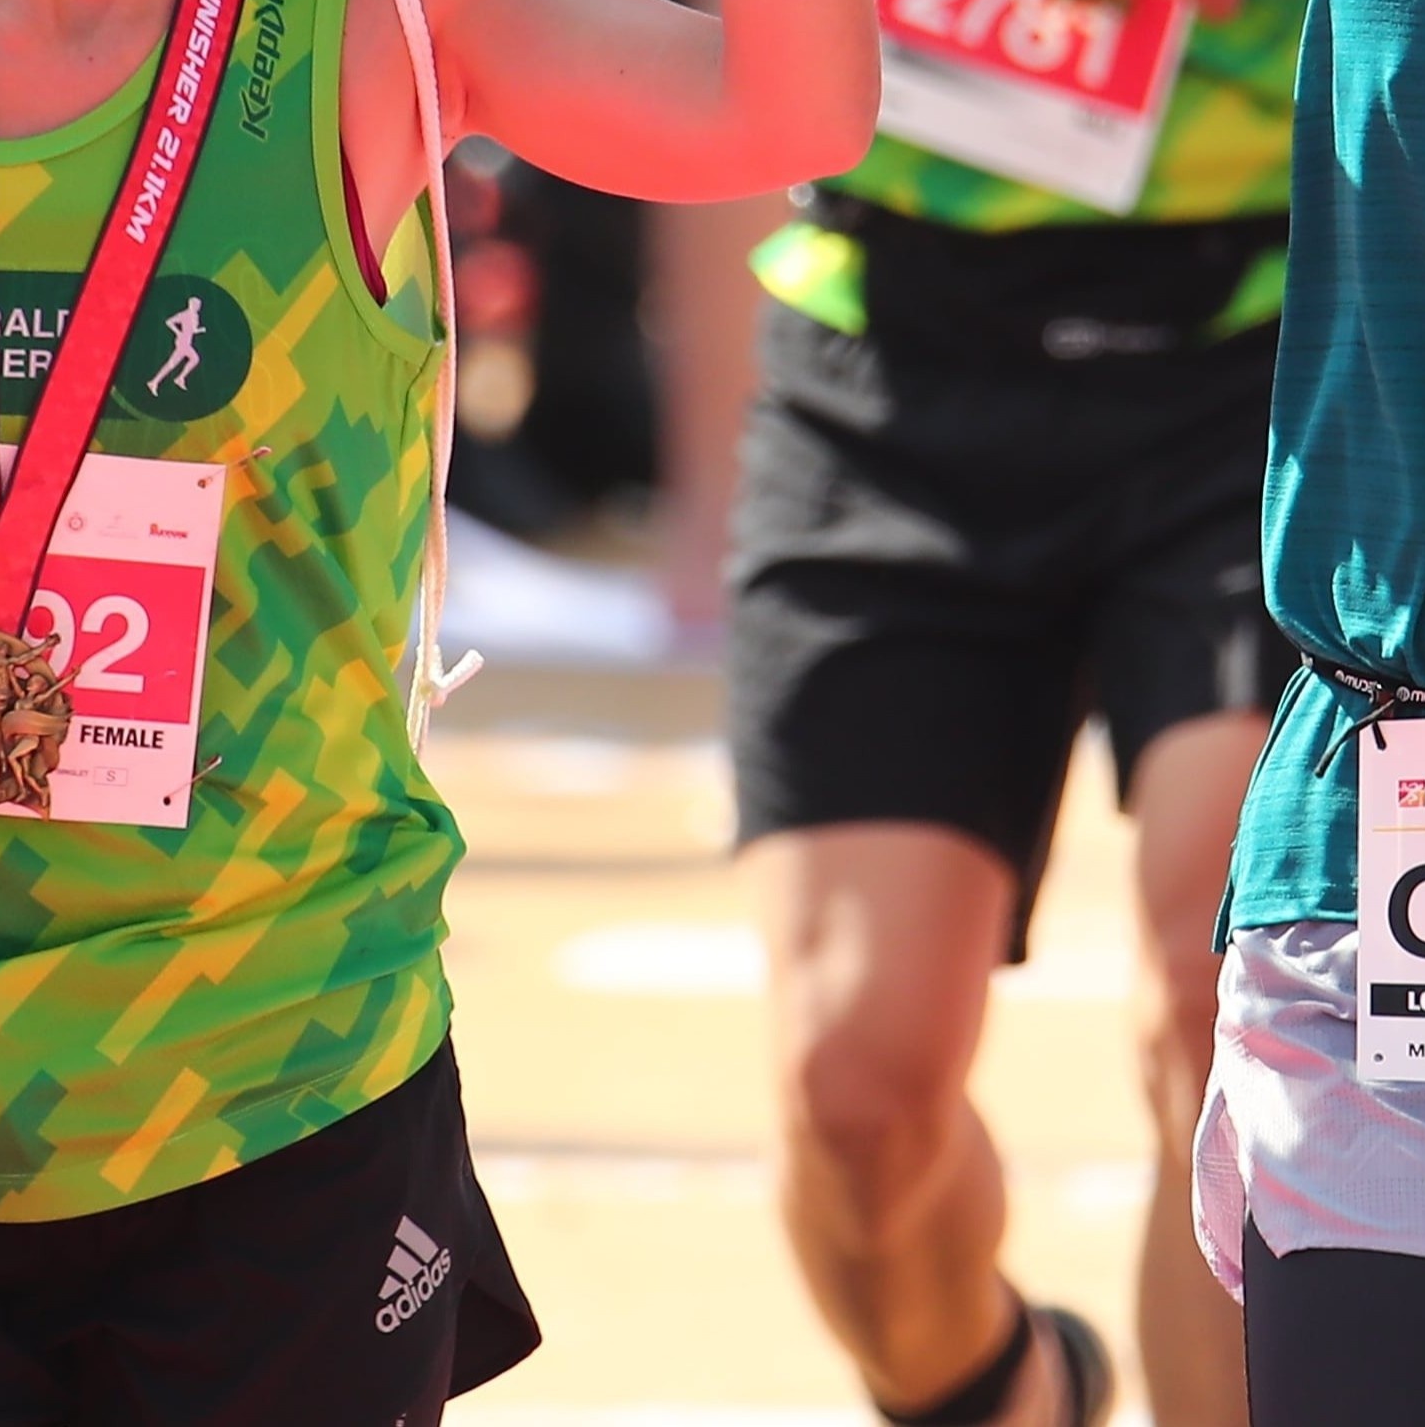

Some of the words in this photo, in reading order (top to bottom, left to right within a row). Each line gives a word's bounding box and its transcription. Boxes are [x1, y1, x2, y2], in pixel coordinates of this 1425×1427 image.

[126, 127, 181, 244] 21.1KM
[80, 724, 164, 749] FEMALE
[106, 770, 116, 782] S
[375, 1248, 451, 1333] adidas
